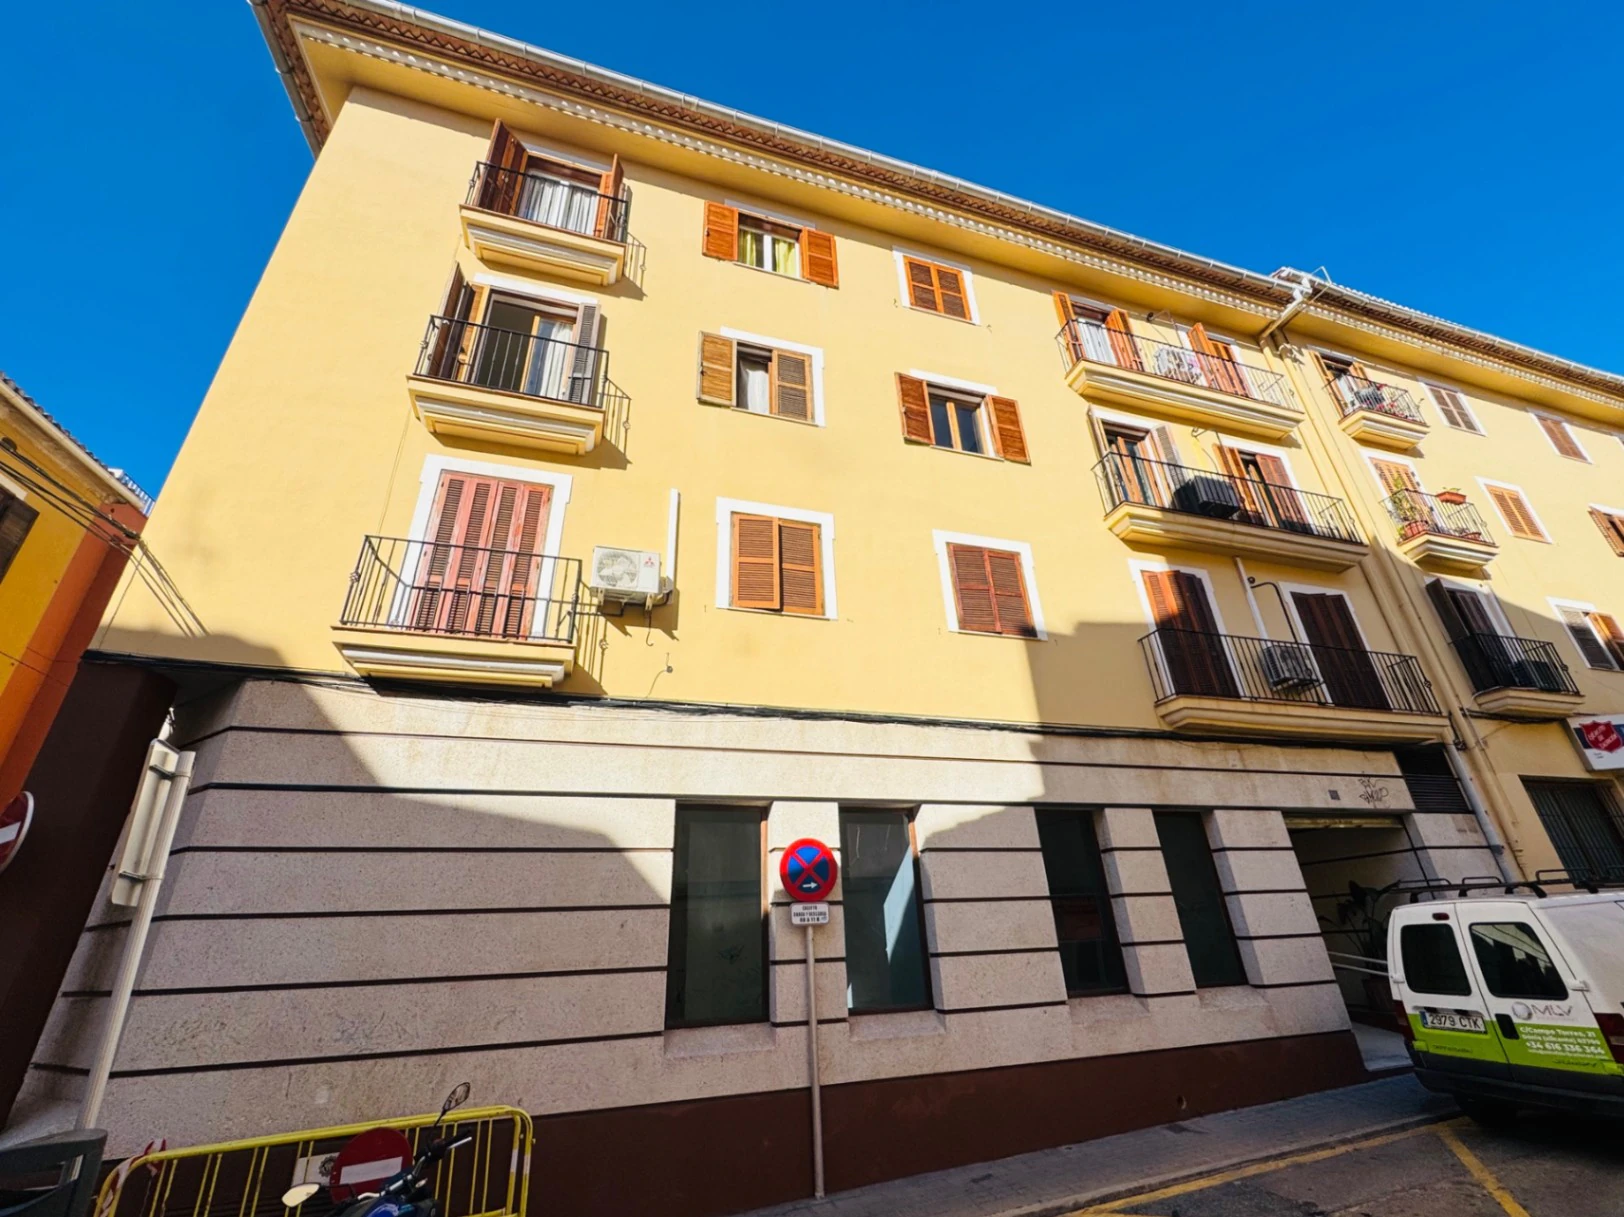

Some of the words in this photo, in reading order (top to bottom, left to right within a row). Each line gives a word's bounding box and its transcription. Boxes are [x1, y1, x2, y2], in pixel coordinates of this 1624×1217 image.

[1531, 1004, 1573, 1016] MLV
[1429, 1014, 1456, 1027] 2979
[1459, 1016, 1481, 1029] CTK
